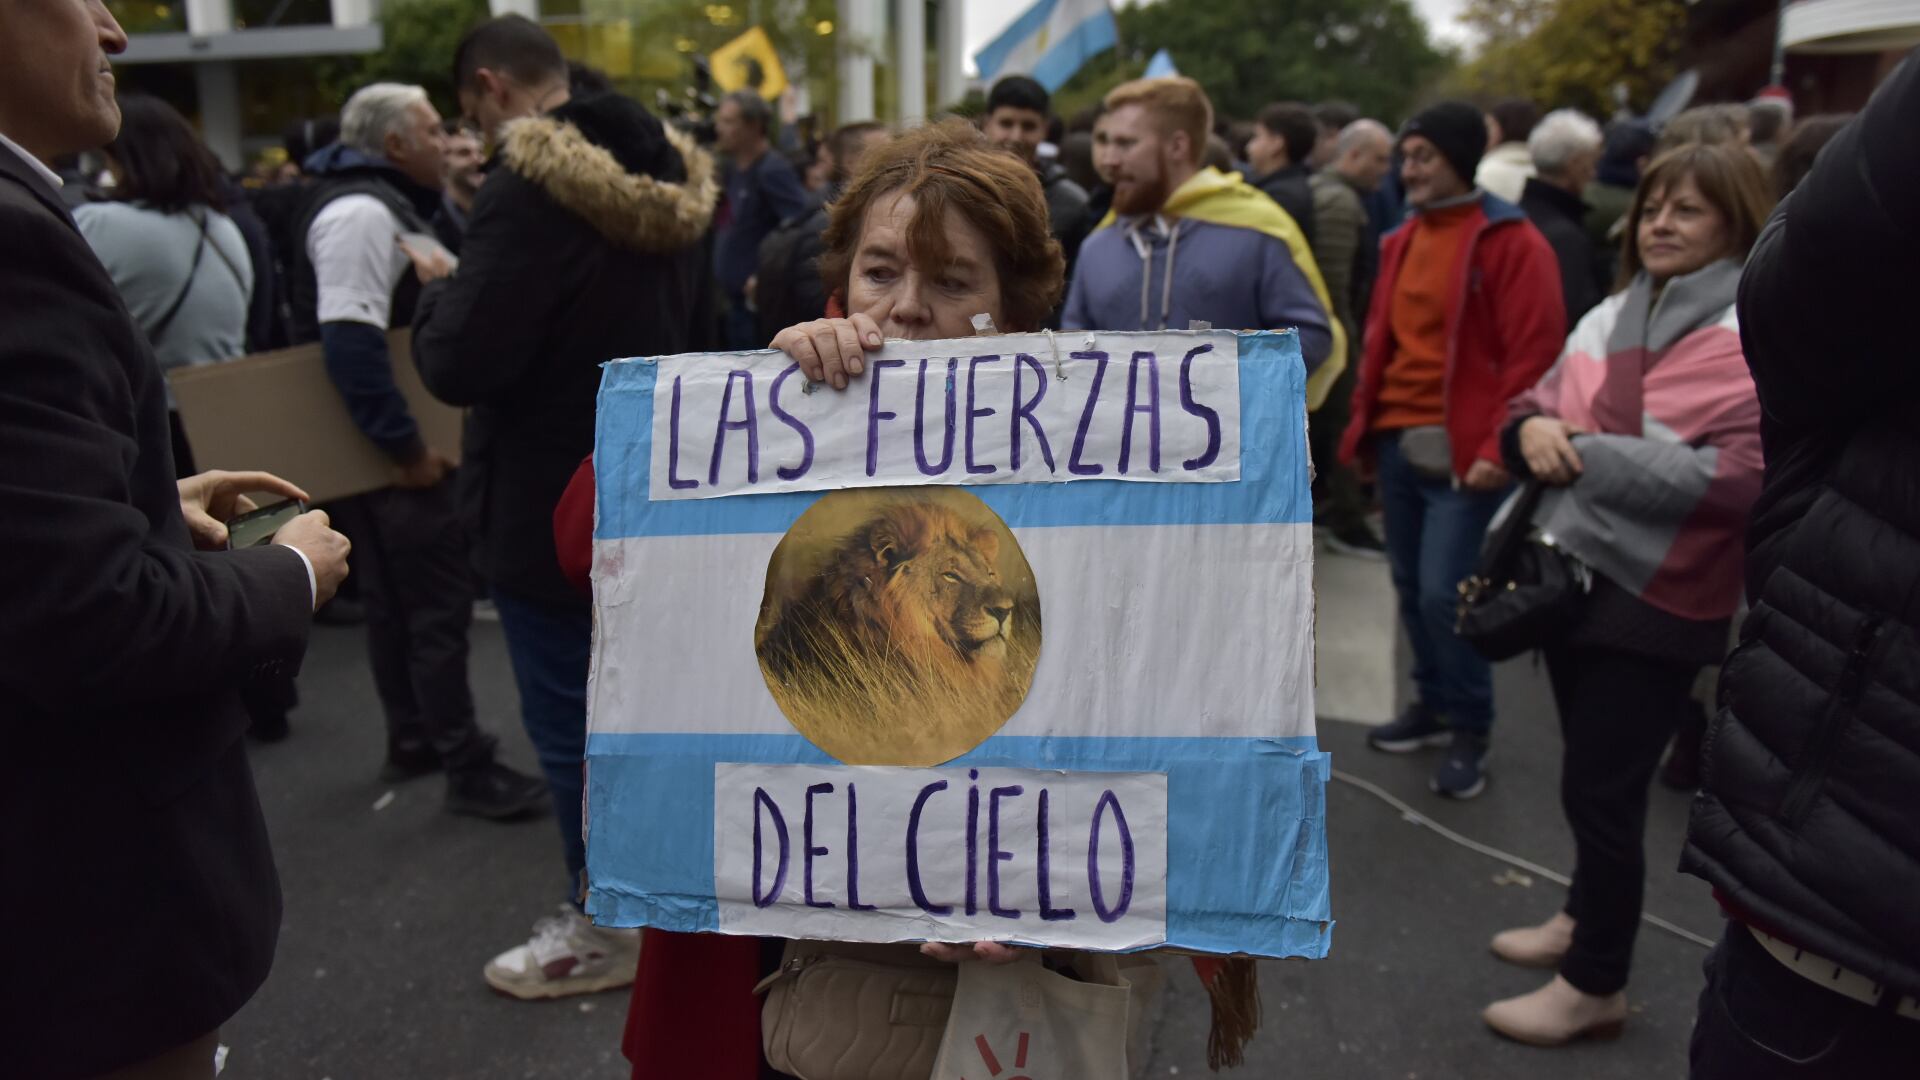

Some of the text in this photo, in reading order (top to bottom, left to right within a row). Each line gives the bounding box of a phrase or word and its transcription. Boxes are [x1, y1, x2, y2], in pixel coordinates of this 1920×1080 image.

[669, 344, 1221, 489] LAS FUERZAS
[752, 782, 878, 910] DEL
